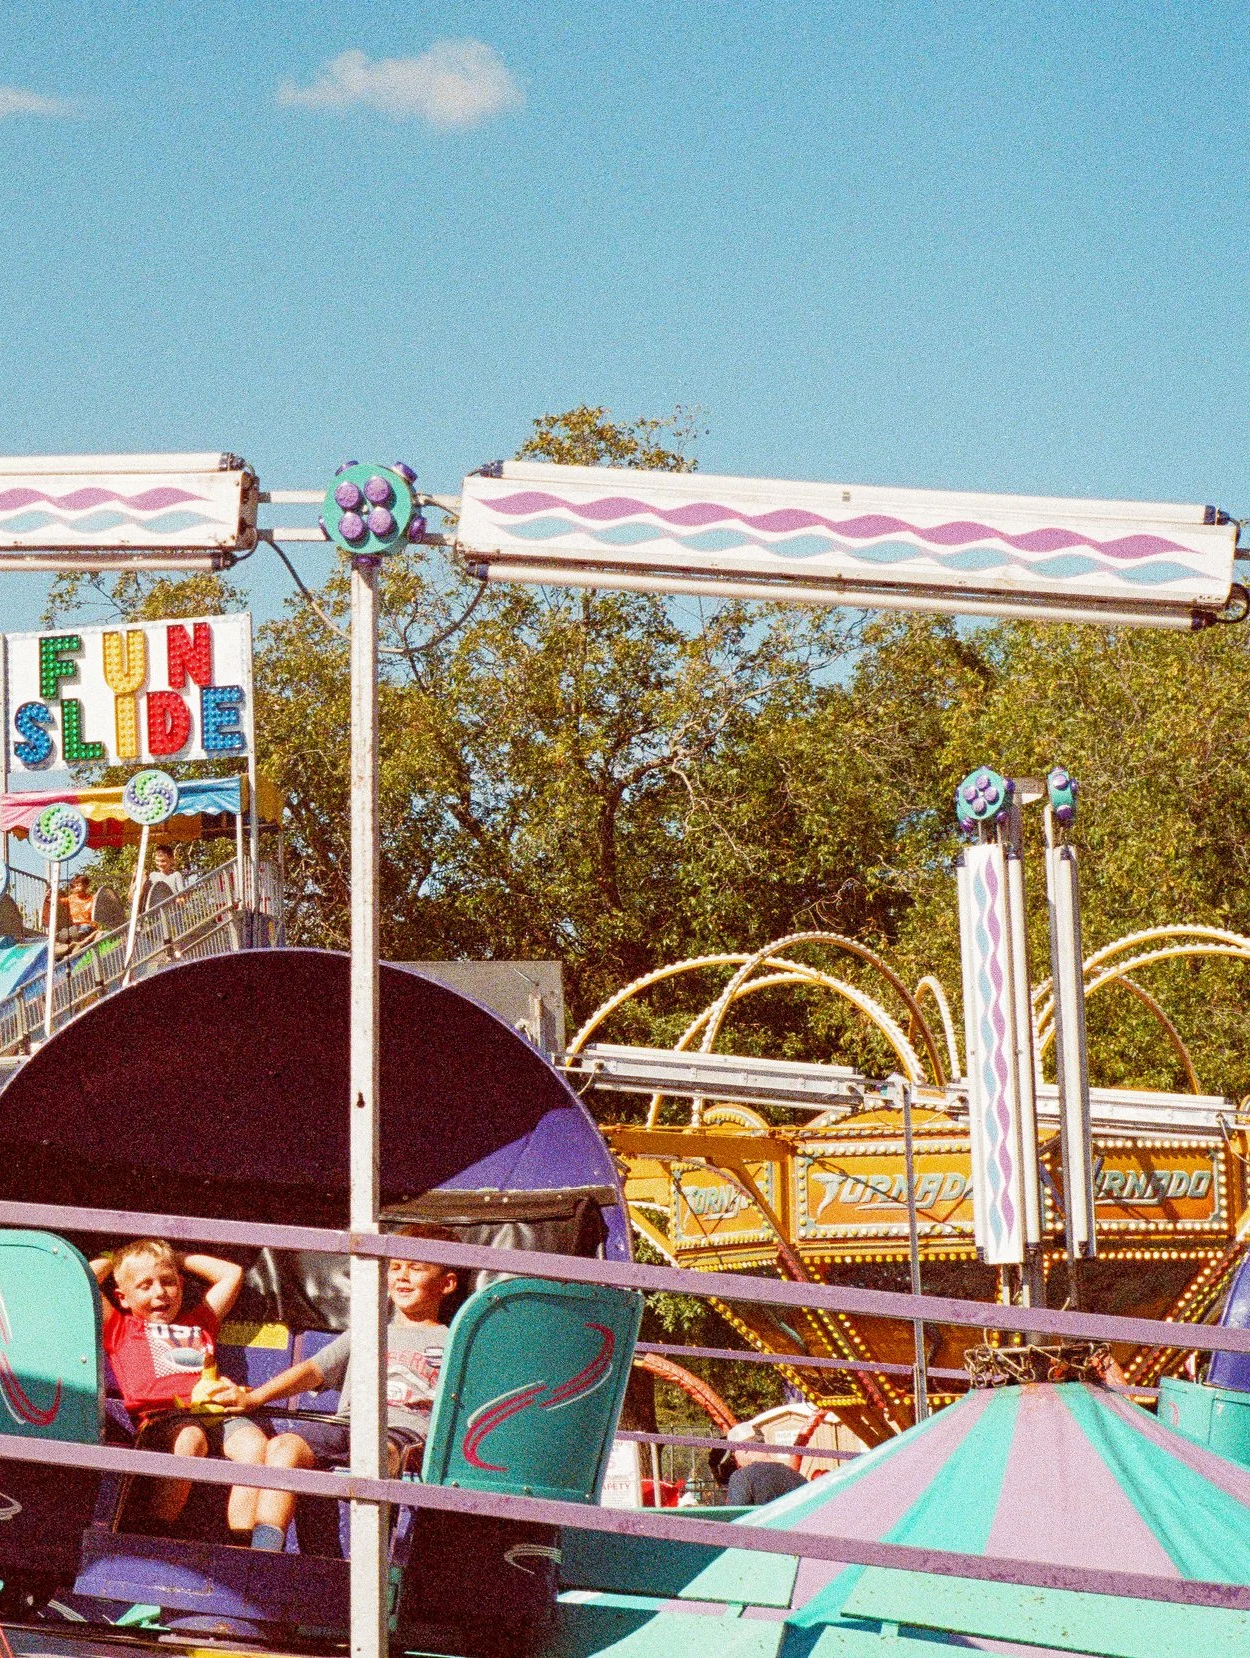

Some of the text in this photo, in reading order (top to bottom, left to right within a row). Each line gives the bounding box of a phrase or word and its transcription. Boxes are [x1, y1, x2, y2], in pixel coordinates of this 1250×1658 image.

[39, 622, 213, 698] FUN
[13, 685, 246, 764] SLIDE
[1095, 1170, 1212, 1205] RNADO
[602, 1482, 631, 1491] AFETY
